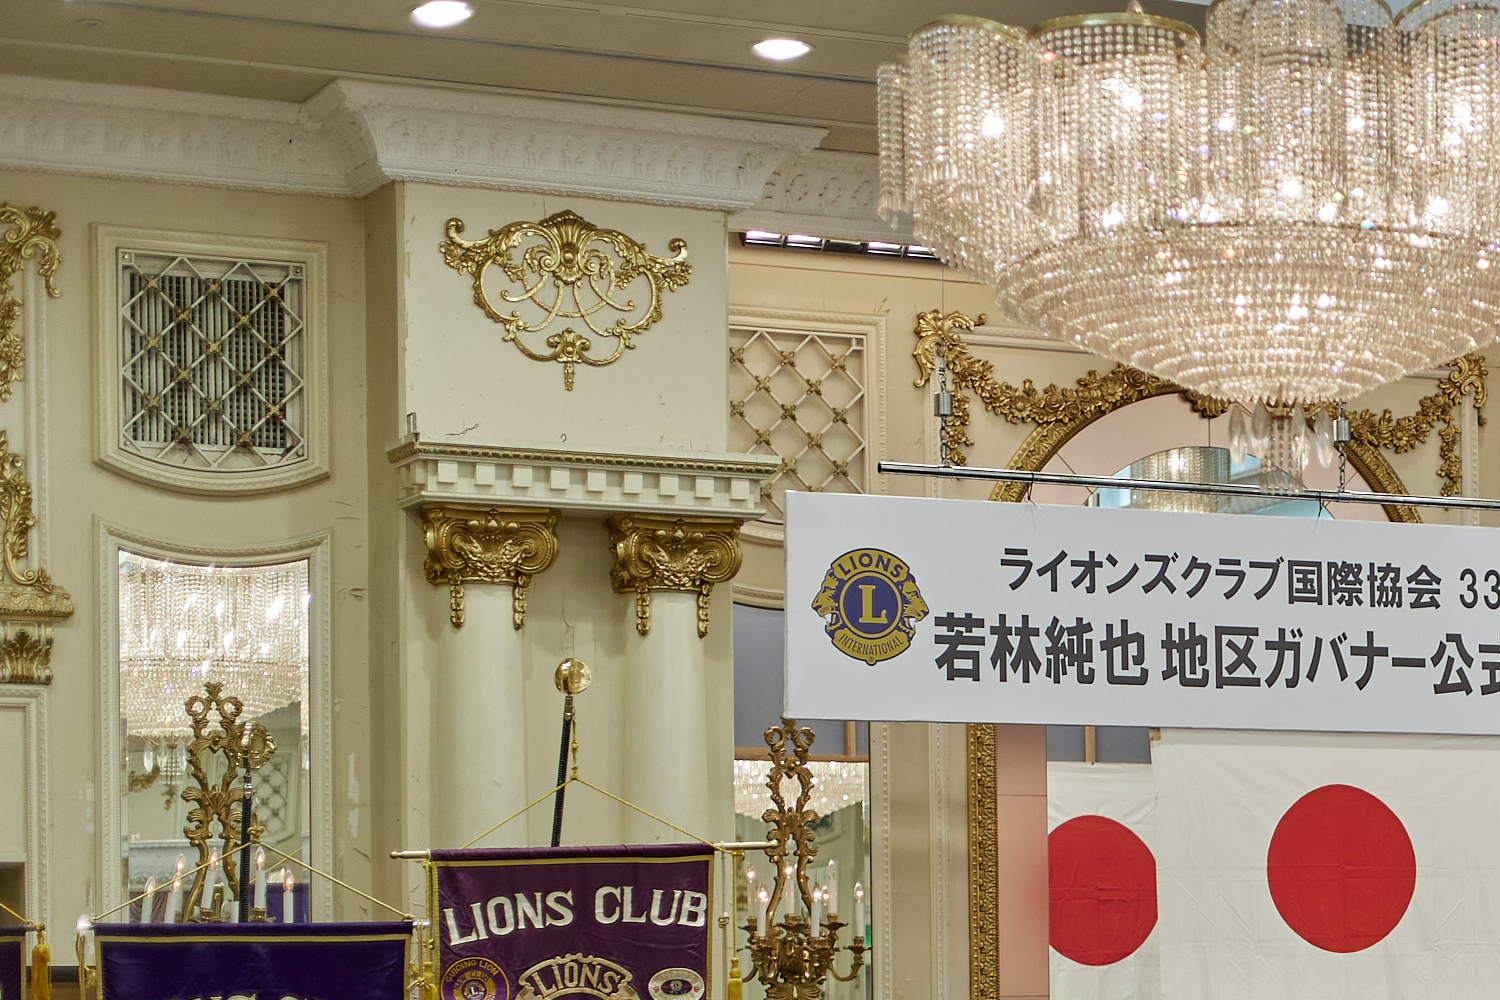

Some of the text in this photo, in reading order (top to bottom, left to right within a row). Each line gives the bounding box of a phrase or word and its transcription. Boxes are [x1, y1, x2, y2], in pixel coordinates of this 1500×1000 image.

[836, 553, 903, 578] LIONS
[1000, 547, 1442, 609] ライオンズクラブ国際協会
[858, 584, 888, 624] L
[838, 633, 904, 656] INTERNATIONAL
[443, 885, 708, 946] LIONS CLUB
[446, 959, 499, 982] GUIDING LION
[453, 971, 490, 990] NEW CLUB
[532, 961, 621, 997] LIONS
